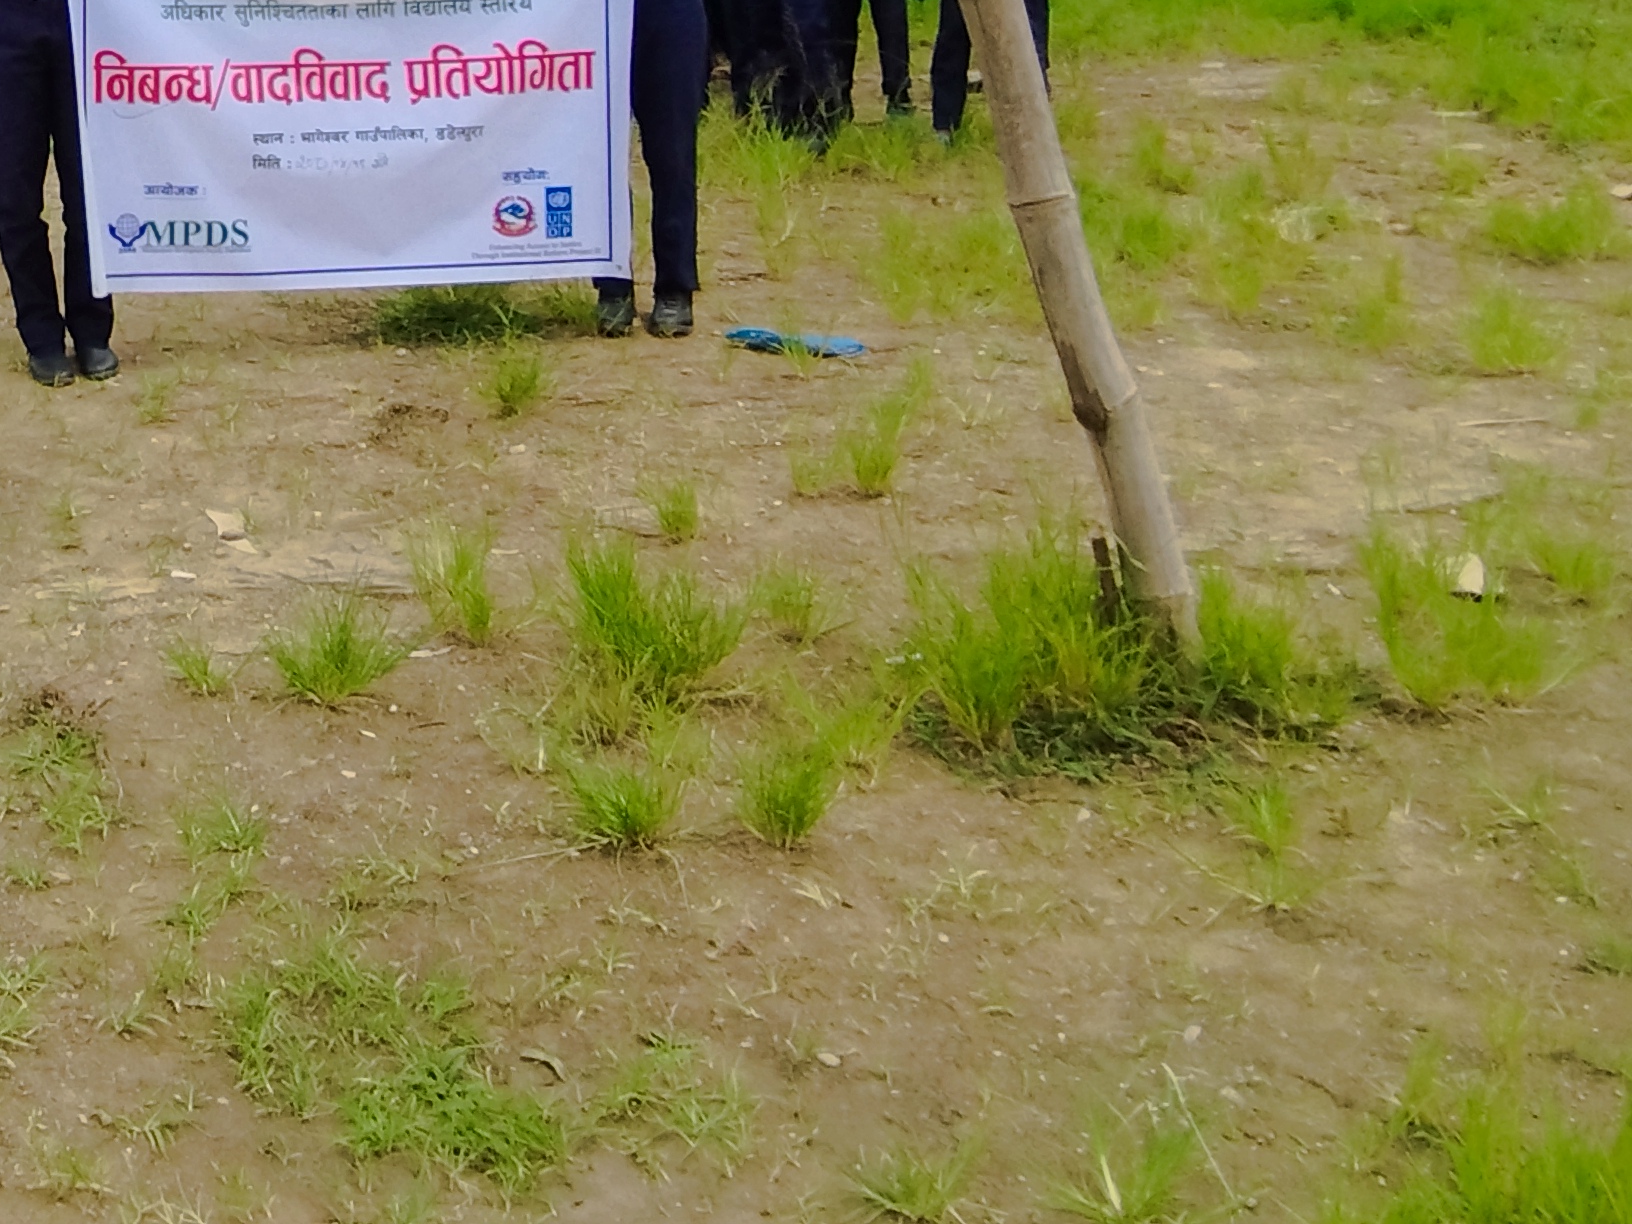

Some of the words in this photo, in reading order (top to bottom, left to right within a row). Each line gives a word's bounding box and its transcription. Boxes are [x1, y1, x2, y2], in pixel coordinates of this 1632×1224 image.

[92, 49, 392, 111] निबन्ध/वादविवाद
[403, 40, 597, 106] प्रतियोगिता
[251, 153, 282, 170] मिति
[143, 218, 249, 248] MPDS
